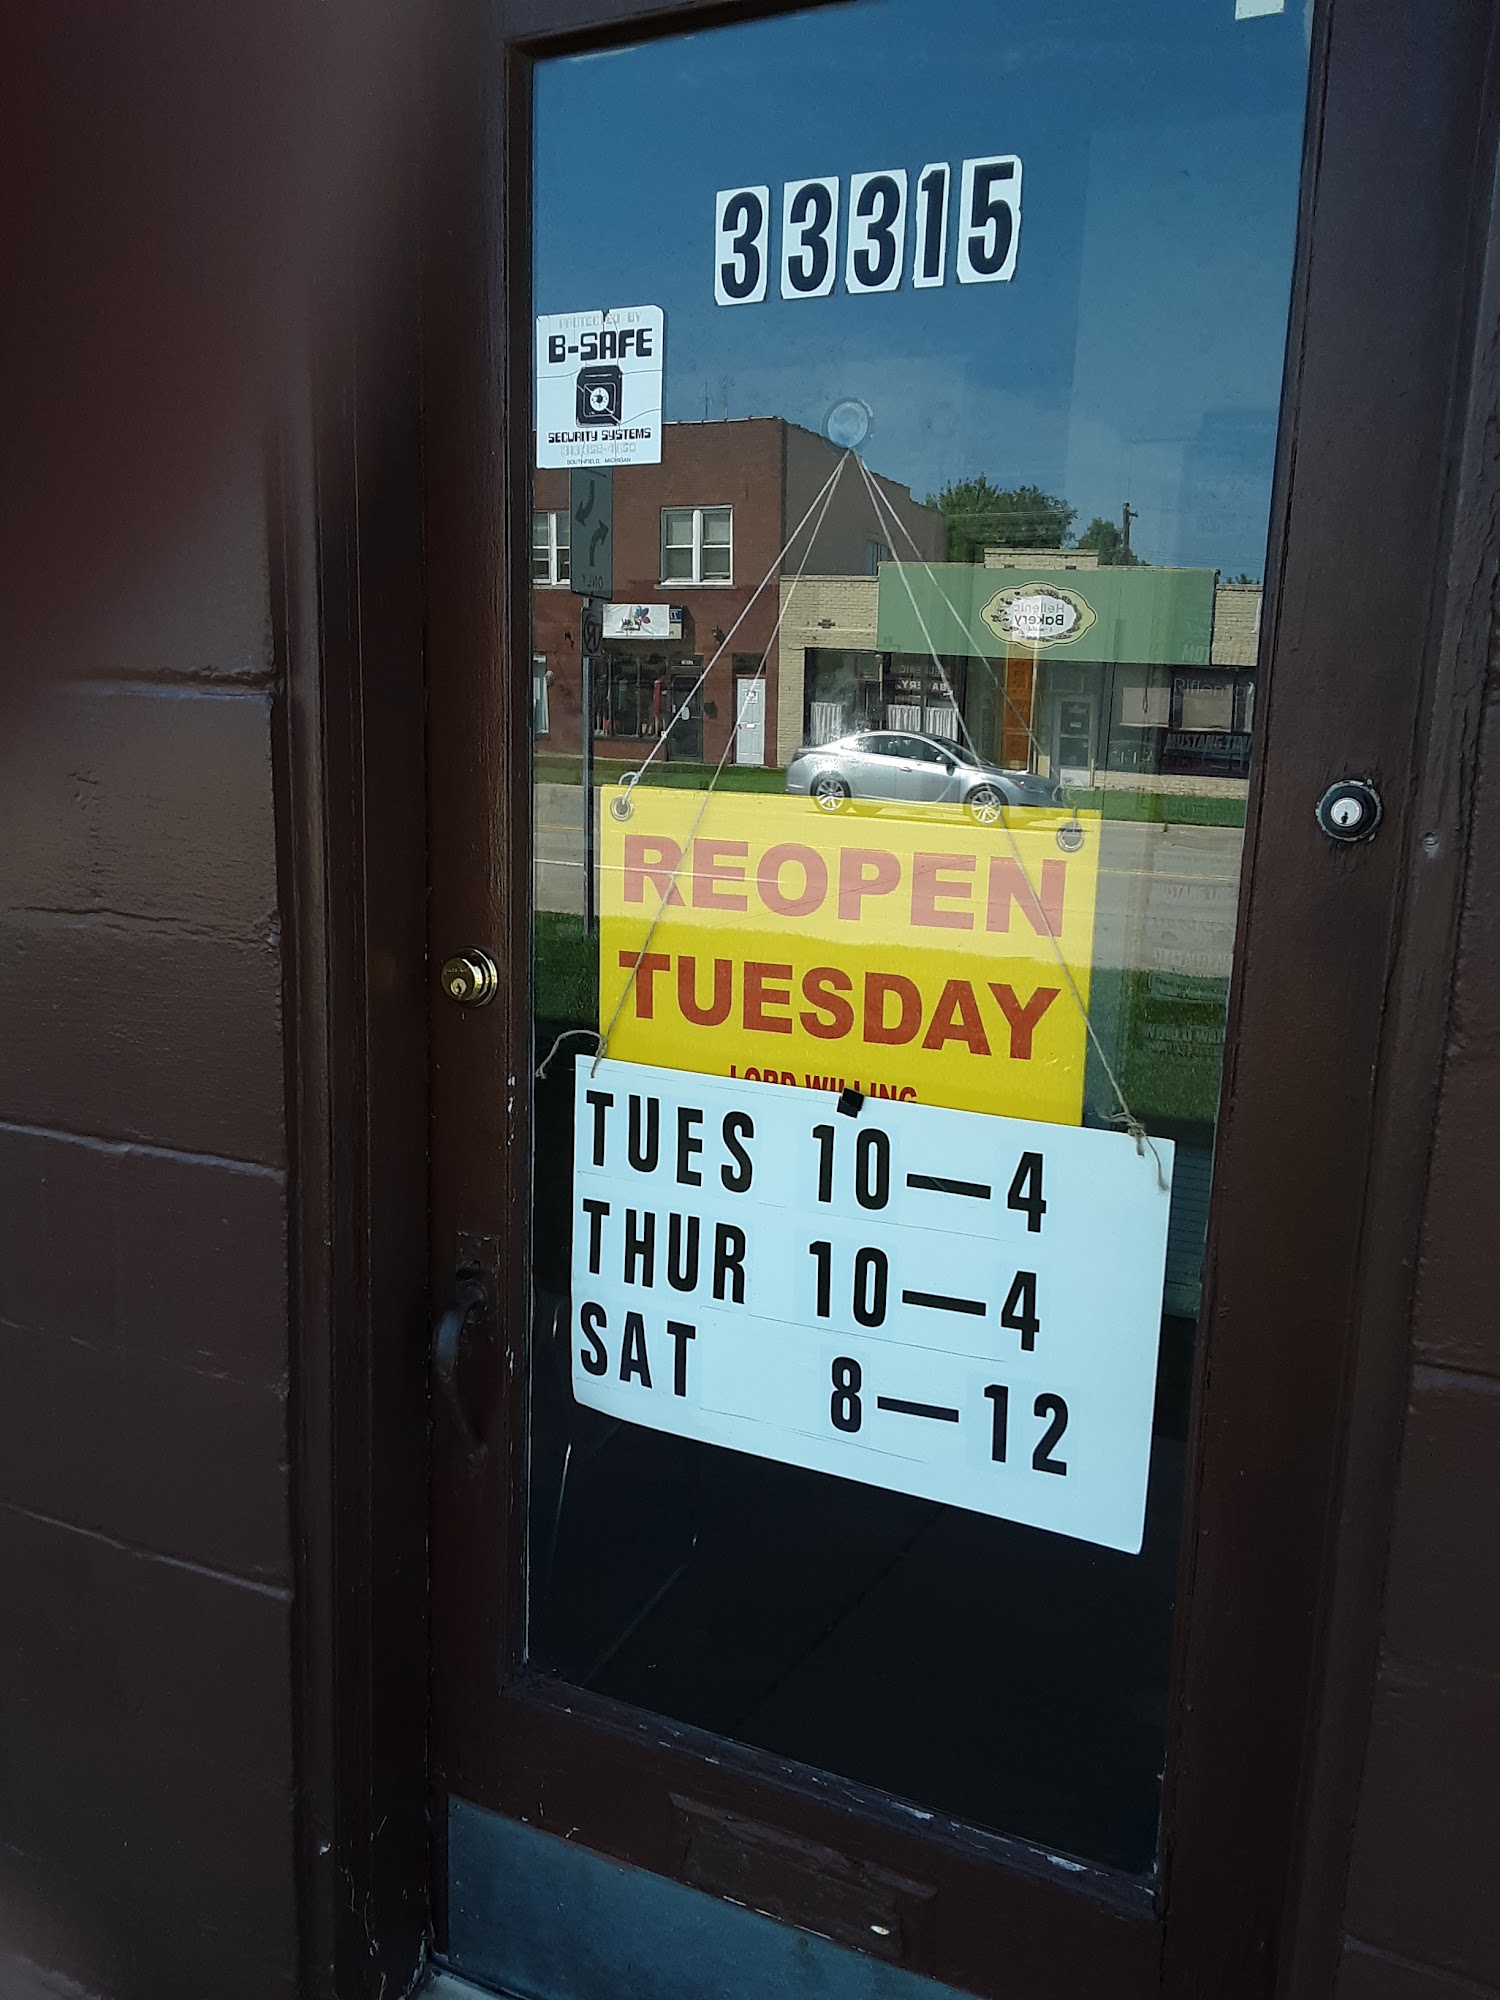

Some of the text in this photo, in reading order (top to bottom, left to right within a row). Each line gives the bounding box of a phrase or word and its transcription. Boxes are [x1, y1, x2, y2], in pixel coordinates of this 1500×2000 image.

[722, 162, 1014, 299] 33315
[548, 328, 653, 364] B-SAFE
[548, 428, 651, 443] SECURITY SYSTEMS
[622, 834, 1067, 938] REOPEN
[618, 950, 1062, 1061] TUESDAY
[586, 1089, 754, 1193] TUES
[582, 1198, 746, 1305] THUR
[579, 1301, 697, 1397] SAT
